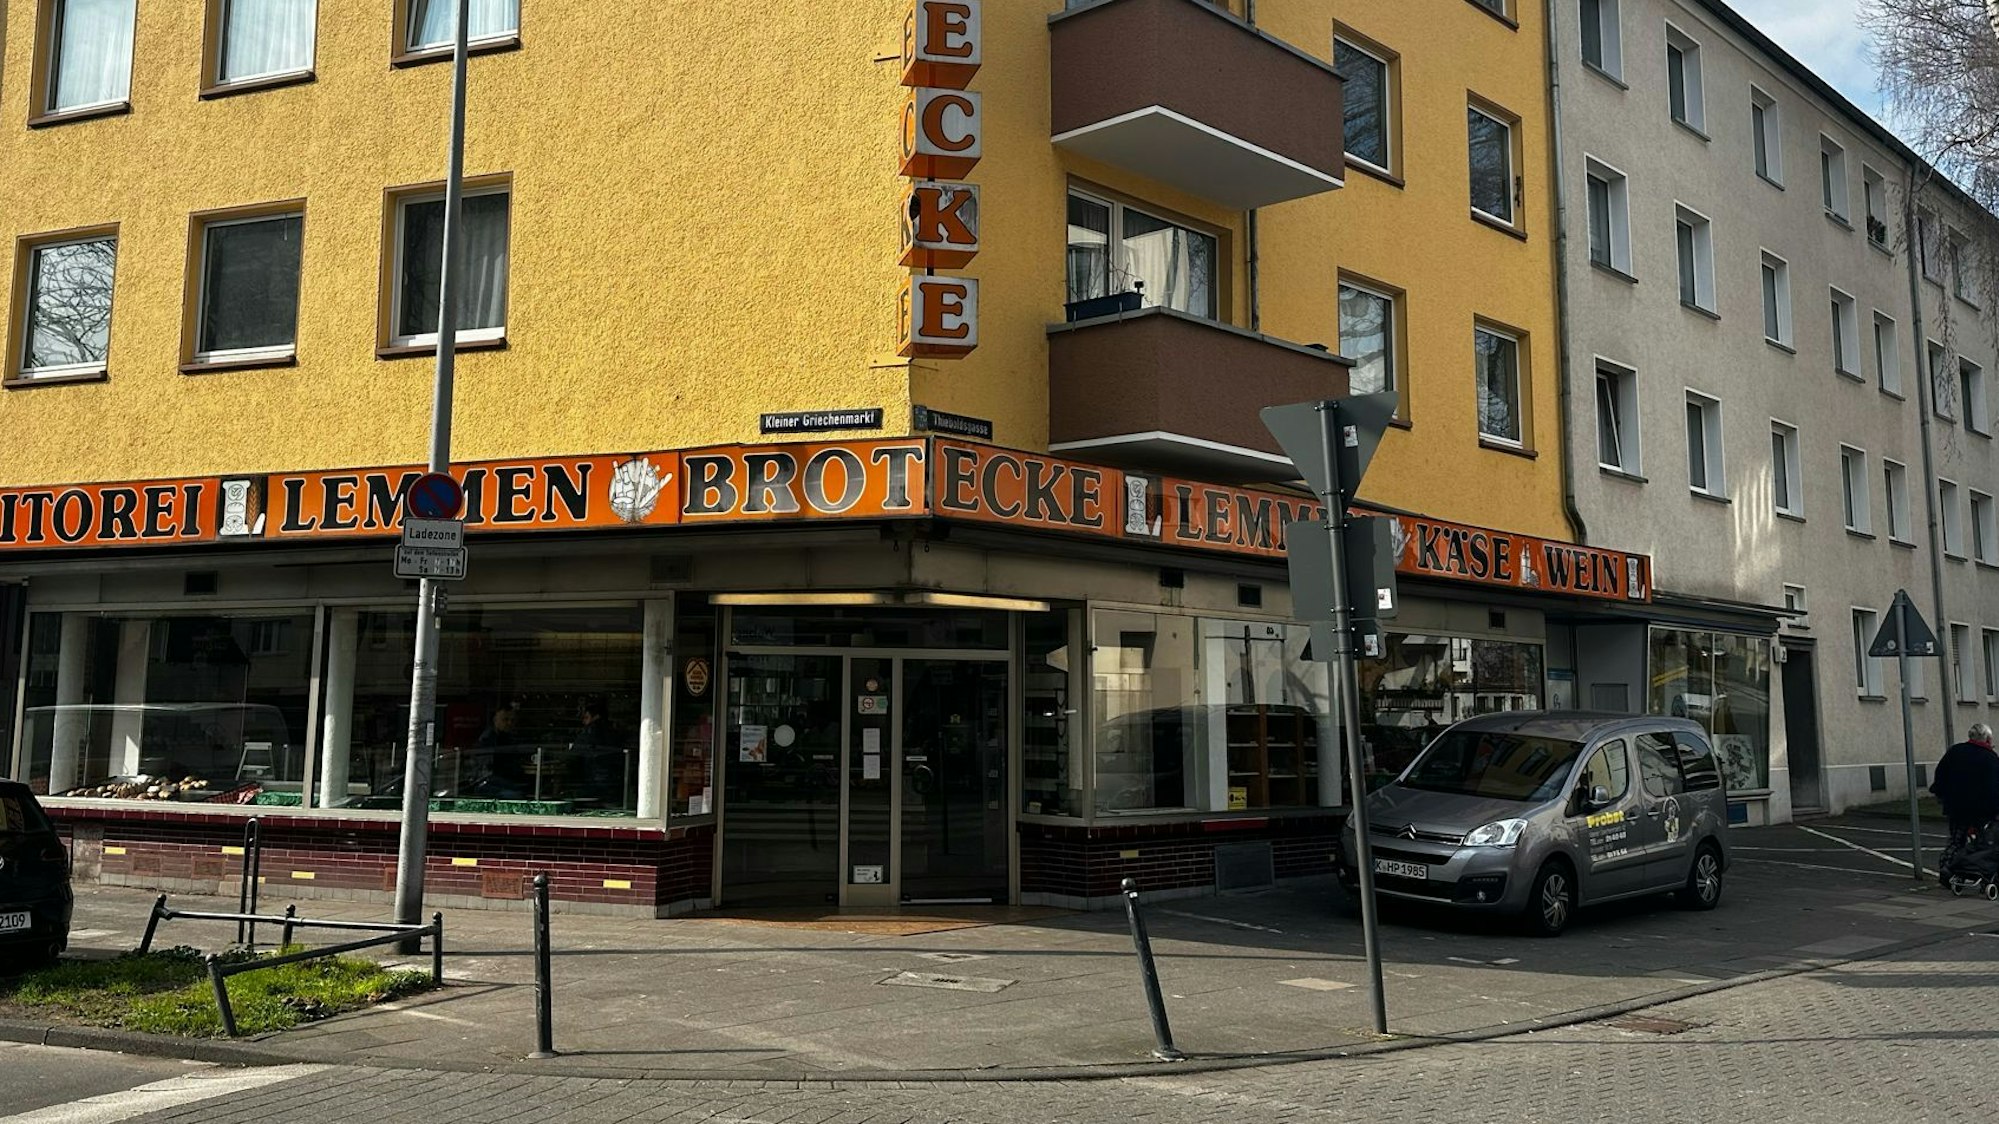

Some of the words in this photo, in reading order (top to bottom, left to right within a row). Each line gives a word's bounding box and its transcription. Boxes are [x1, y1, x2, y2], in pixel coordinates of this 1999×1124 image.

[765, 415, 799, 429] Kleiner
[803, 412, 875, 427] Griechenmarkt
[932, 413, 988, 435] Thieboldsgasse
[0, 484, 203, 544] ITOREI
[683, 446, 924, 515] BROT
[941, 446, 1104, 528] ECKE
[1415, 522, 1512, 581] KÄSE
[1544, 543, 1618, 595] WEIN
[409, 528, 456, 540] Ladezone
[401, 556, 412, 564] Mo
